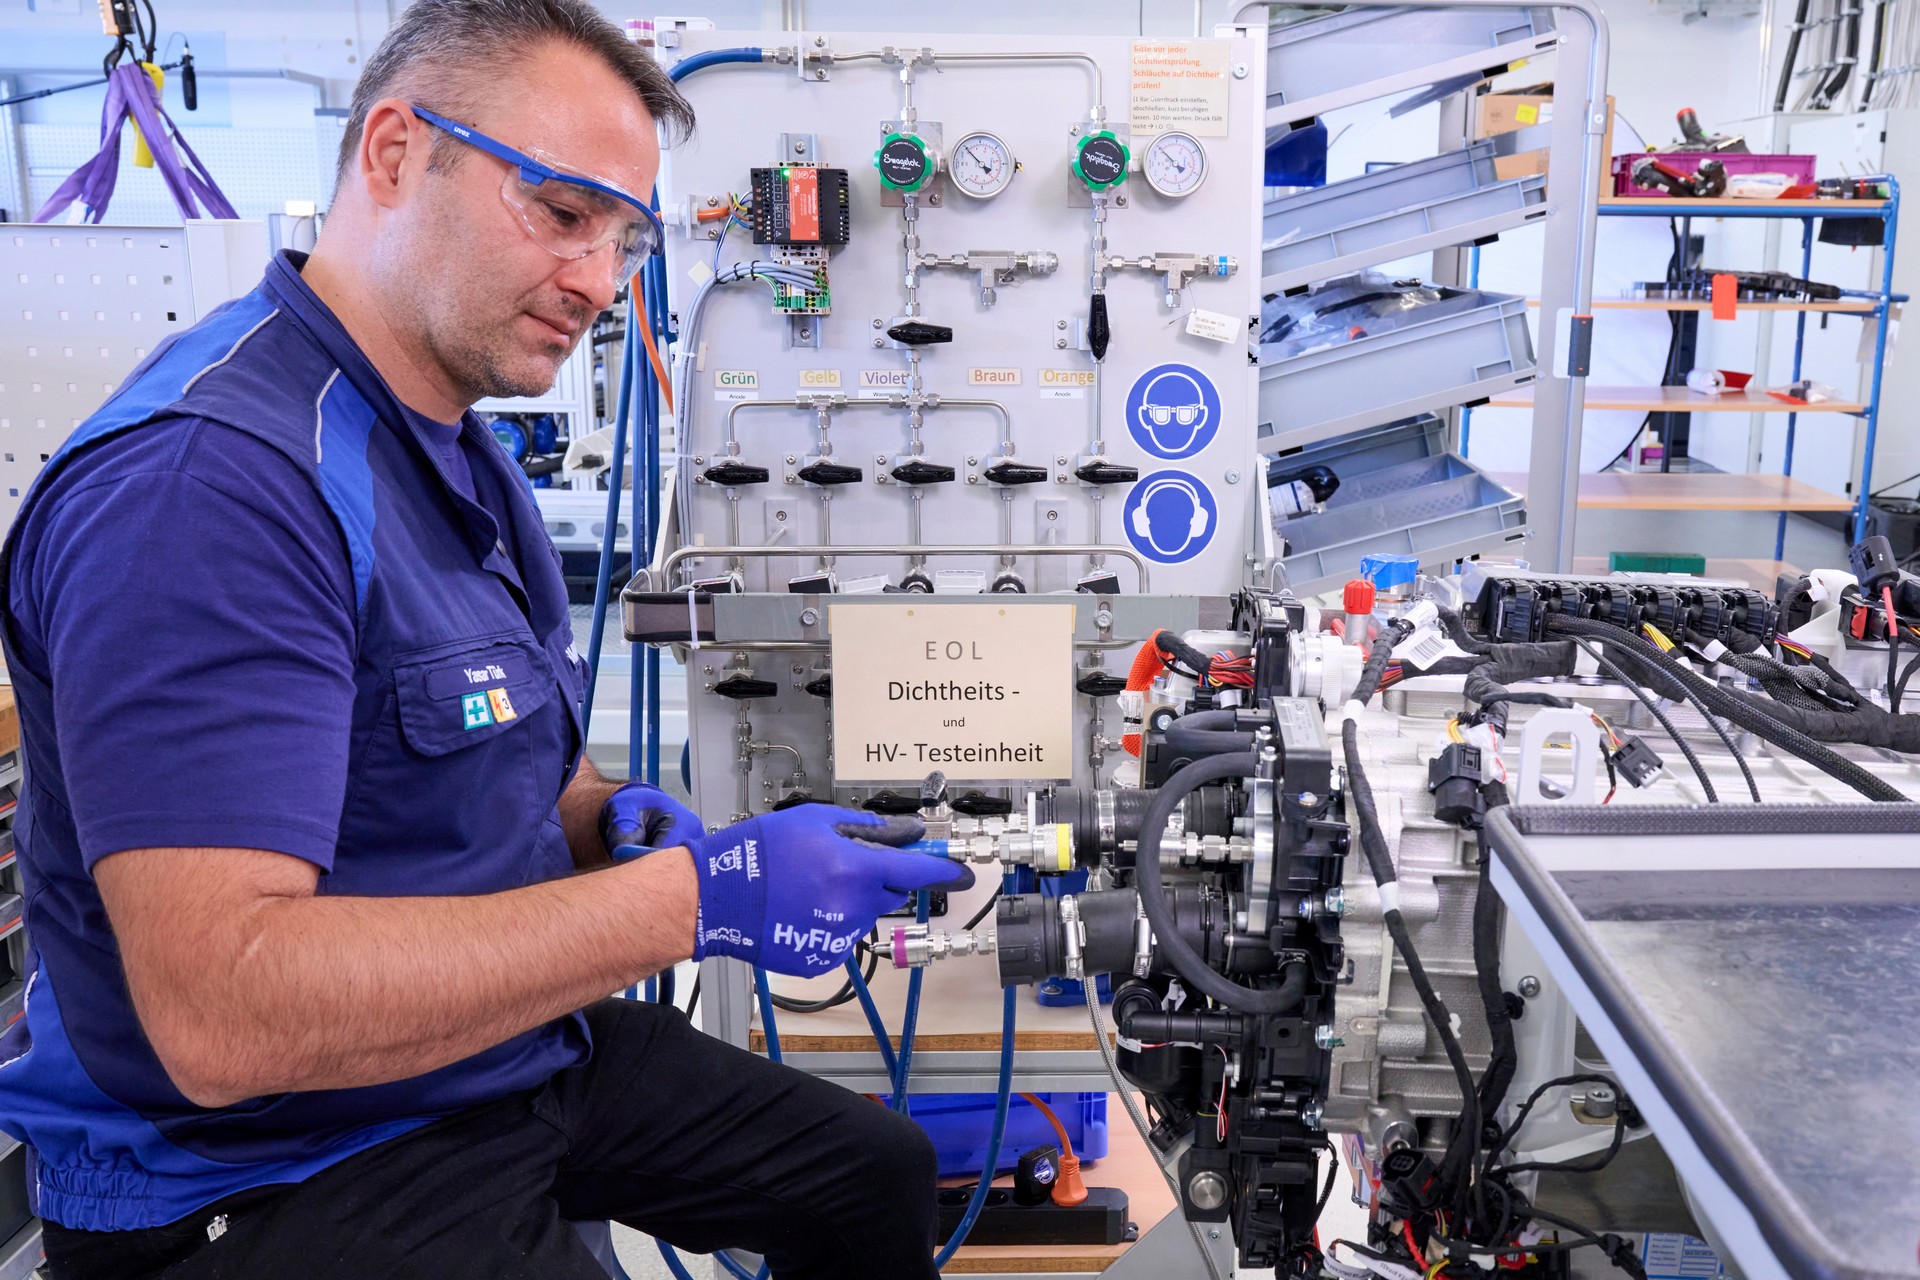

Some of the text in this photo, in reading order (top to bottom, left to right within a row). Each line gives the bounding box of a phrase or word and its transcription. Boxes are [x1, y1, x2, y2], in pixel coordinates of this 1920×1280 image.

[1167, 46, 1187, 54] jeder
[1133, 69, 1170, 77] Schläuche
[1172, 70, 1184, 78] auf
[1133, 81, 1161, 90] prüfen!
[453, 126, 470, 138] uvex
[720, 371, 756, 385] Grün
[804, 370, 837, 384] Gelb
[974, 369, 1015, 382] Braun
[1043, 369, 1095, 386] Orange
[888, 680, 1005, 701] Dichtheits
[501, 698, 510, 710] 3
[943, 717, 965, 728] und
[865, 742, 1044, 762] HV- Testeinheit
[746, 839, 761, 878] Ansell
[813, 908, 844, 922] 11-618
